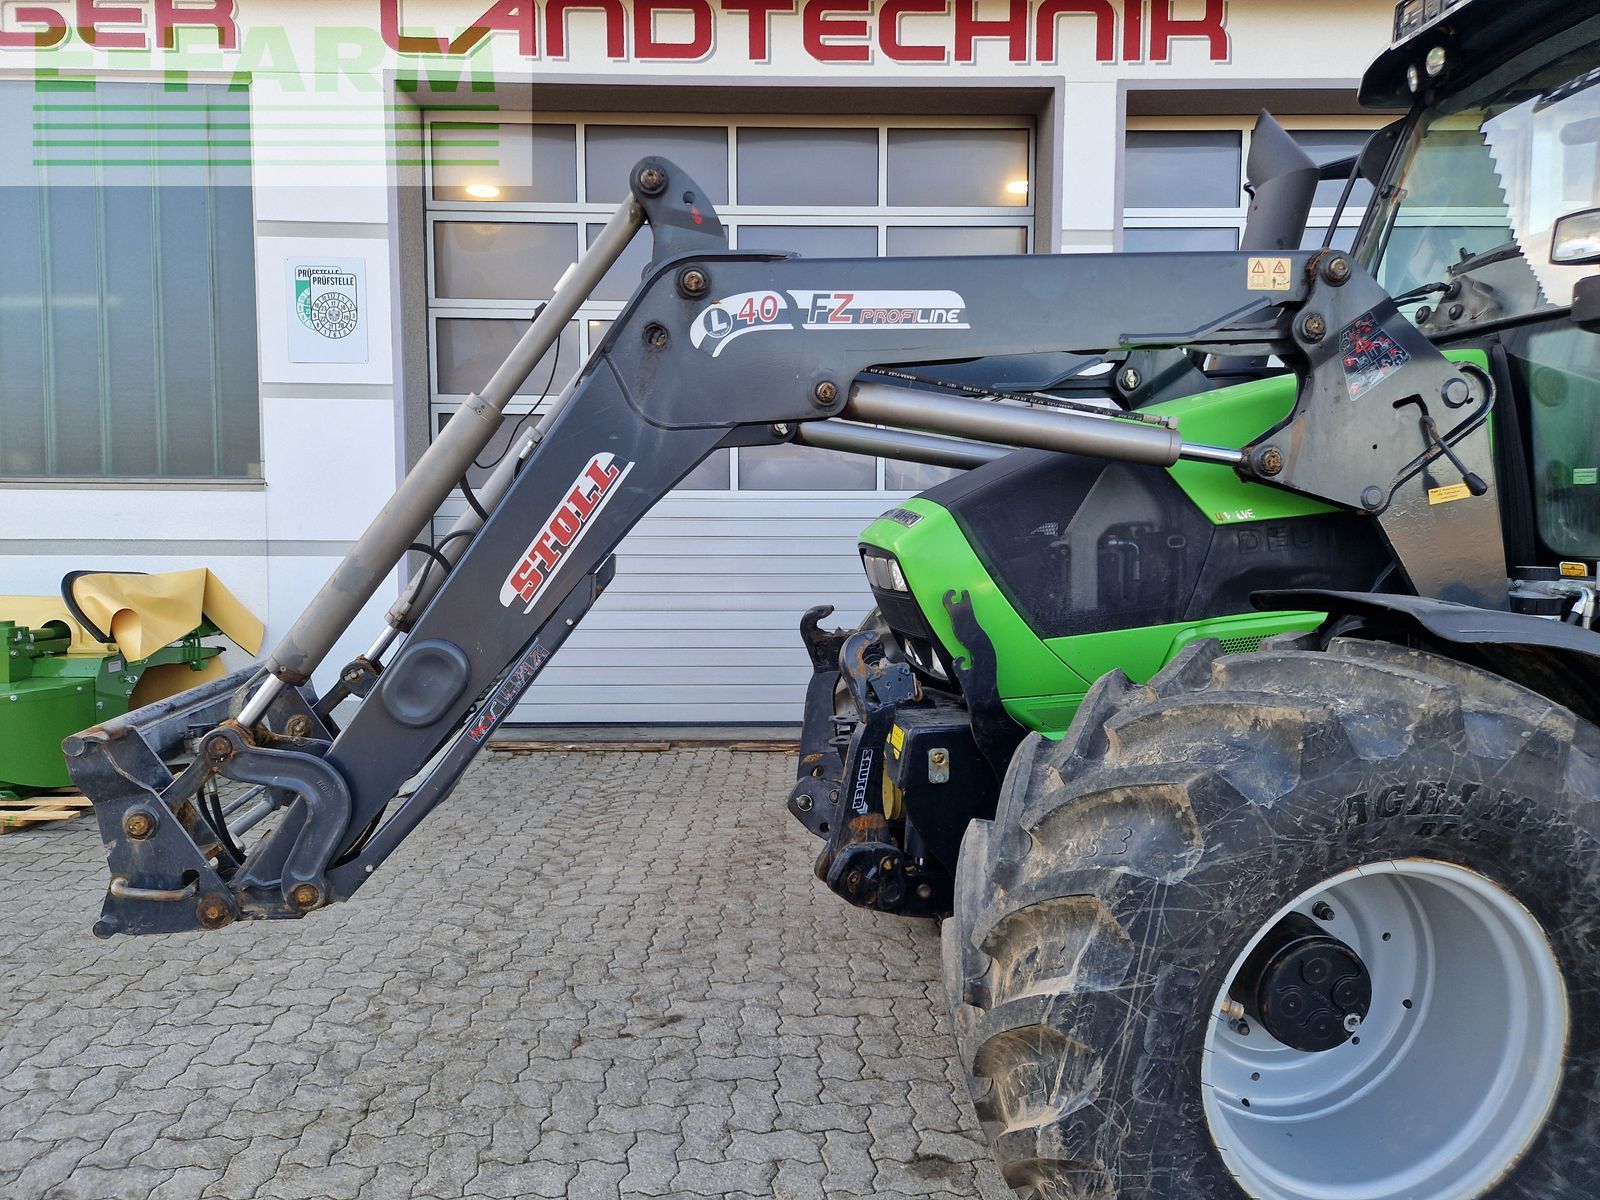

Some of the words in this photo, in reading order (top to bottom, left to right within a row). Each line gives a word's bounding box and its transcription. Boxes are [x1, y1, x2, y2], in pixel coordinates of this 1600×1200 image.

[381, 0, 1228, 62] LANDTECHNIK
[313, 275, 354, 286] PRÜFSTELLE
[737, 295, 778, 325] 40
[808, 293, 854, 324] FZ
[859, 308, 960, 324] PROFILINE
[510, 458, 620, 602] STOLL
[852, 748, 874, 809] SAUTER
